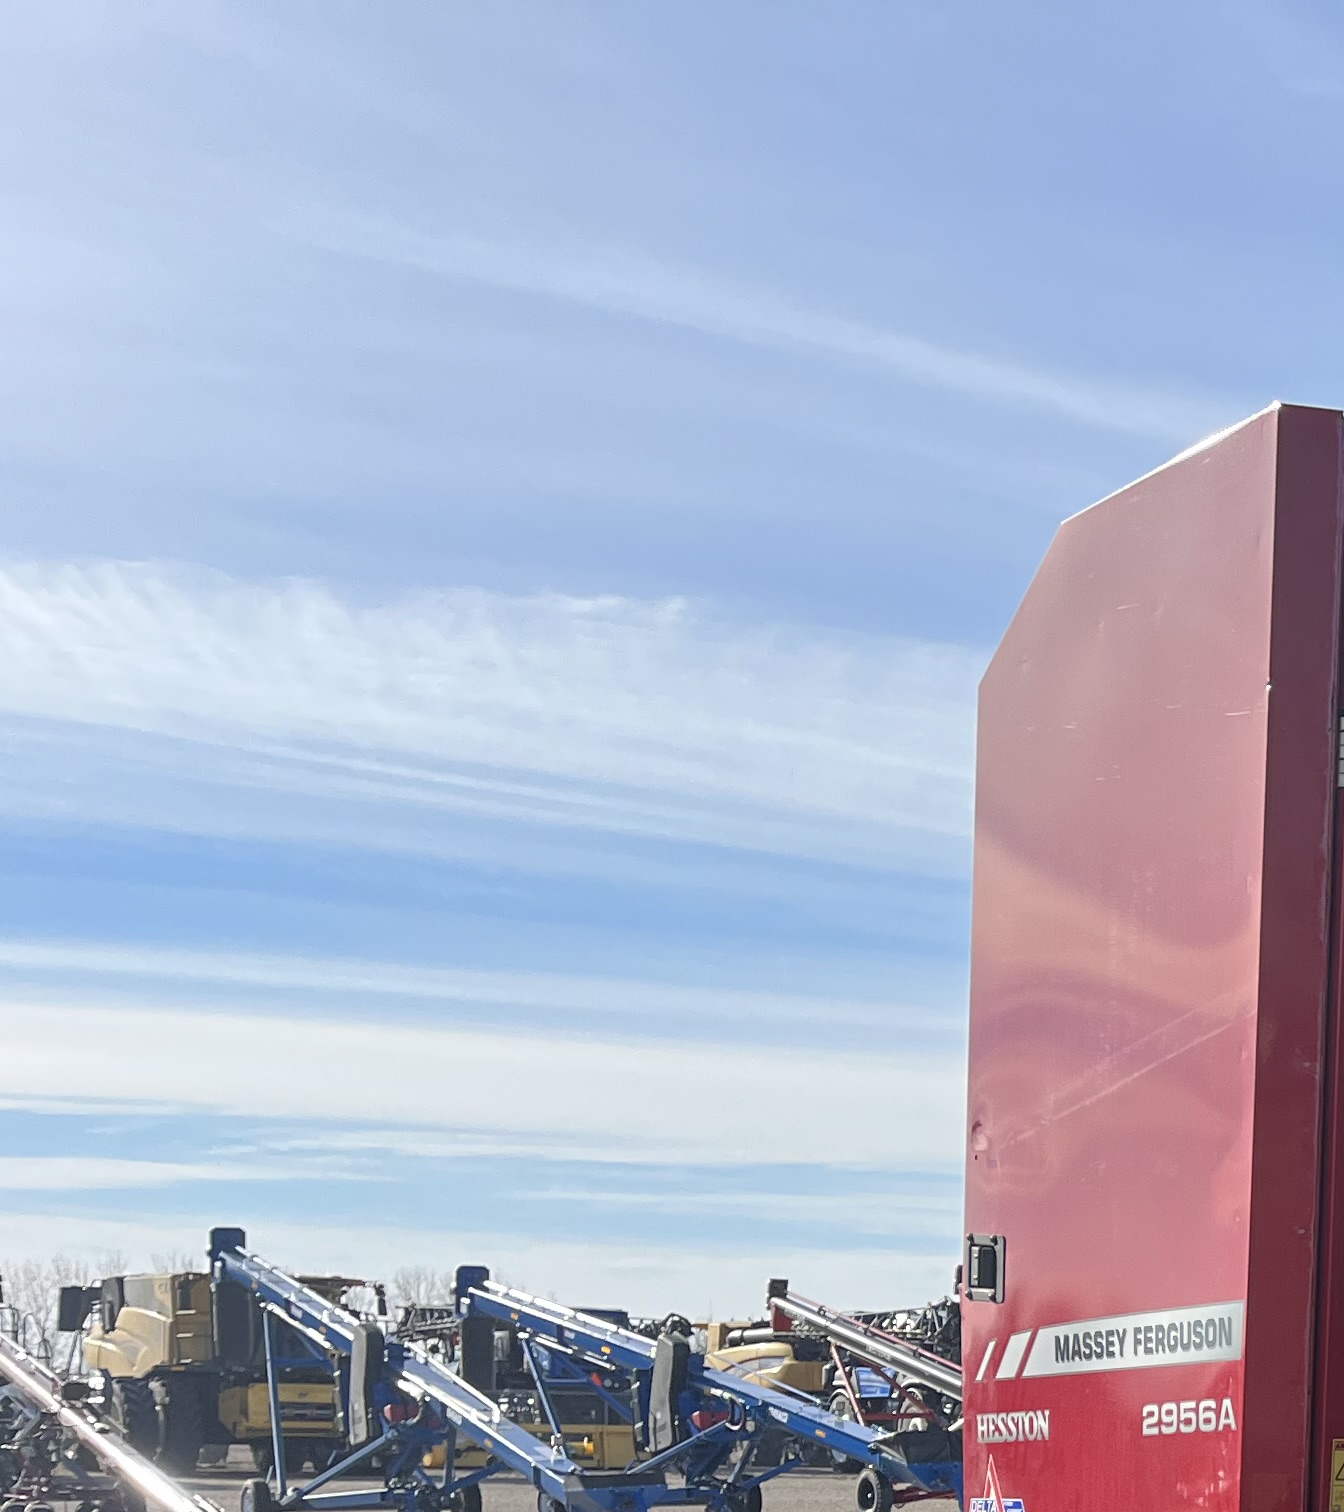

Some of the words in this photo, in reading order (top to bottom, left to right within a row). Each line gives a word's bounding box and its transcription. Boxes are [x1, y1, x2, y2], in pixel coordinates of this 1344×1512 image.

[1054, 1328, 1127, 1364] MASSEY
[1133, 1316, 1233, 1357] FERGUSON
[976, 1409, 1050, 1443] HESSTON
[1141, 1397, 1238, 1437] 2956A
